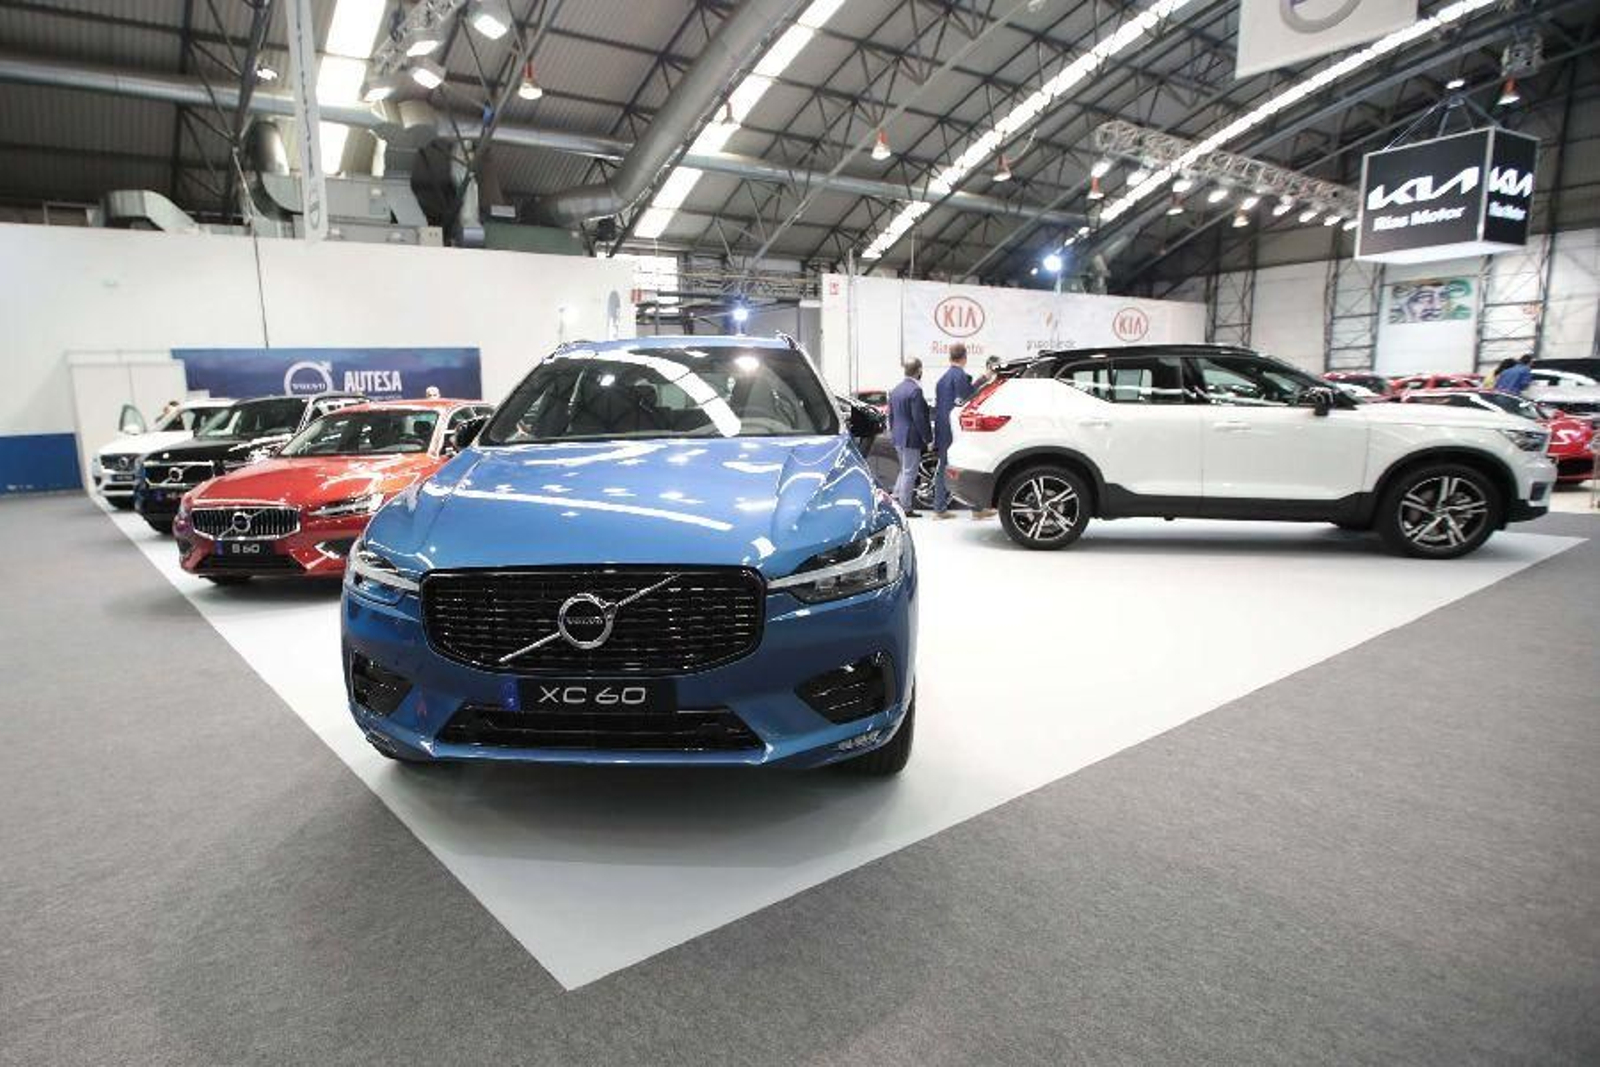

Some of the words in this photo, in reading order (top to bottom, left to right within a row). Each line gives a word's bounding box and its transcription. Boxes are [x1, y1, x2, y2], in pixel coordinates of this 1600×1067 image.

[1368, 166, 1480, 210] KIA
[943, 304, 977, 328] KIA
[1119, 316, 1142, 335] KIA
[343, 370, 403, 393] AUTESA
[538, 685, 587, 704] XC
[595, 686, 647, 705] 60
